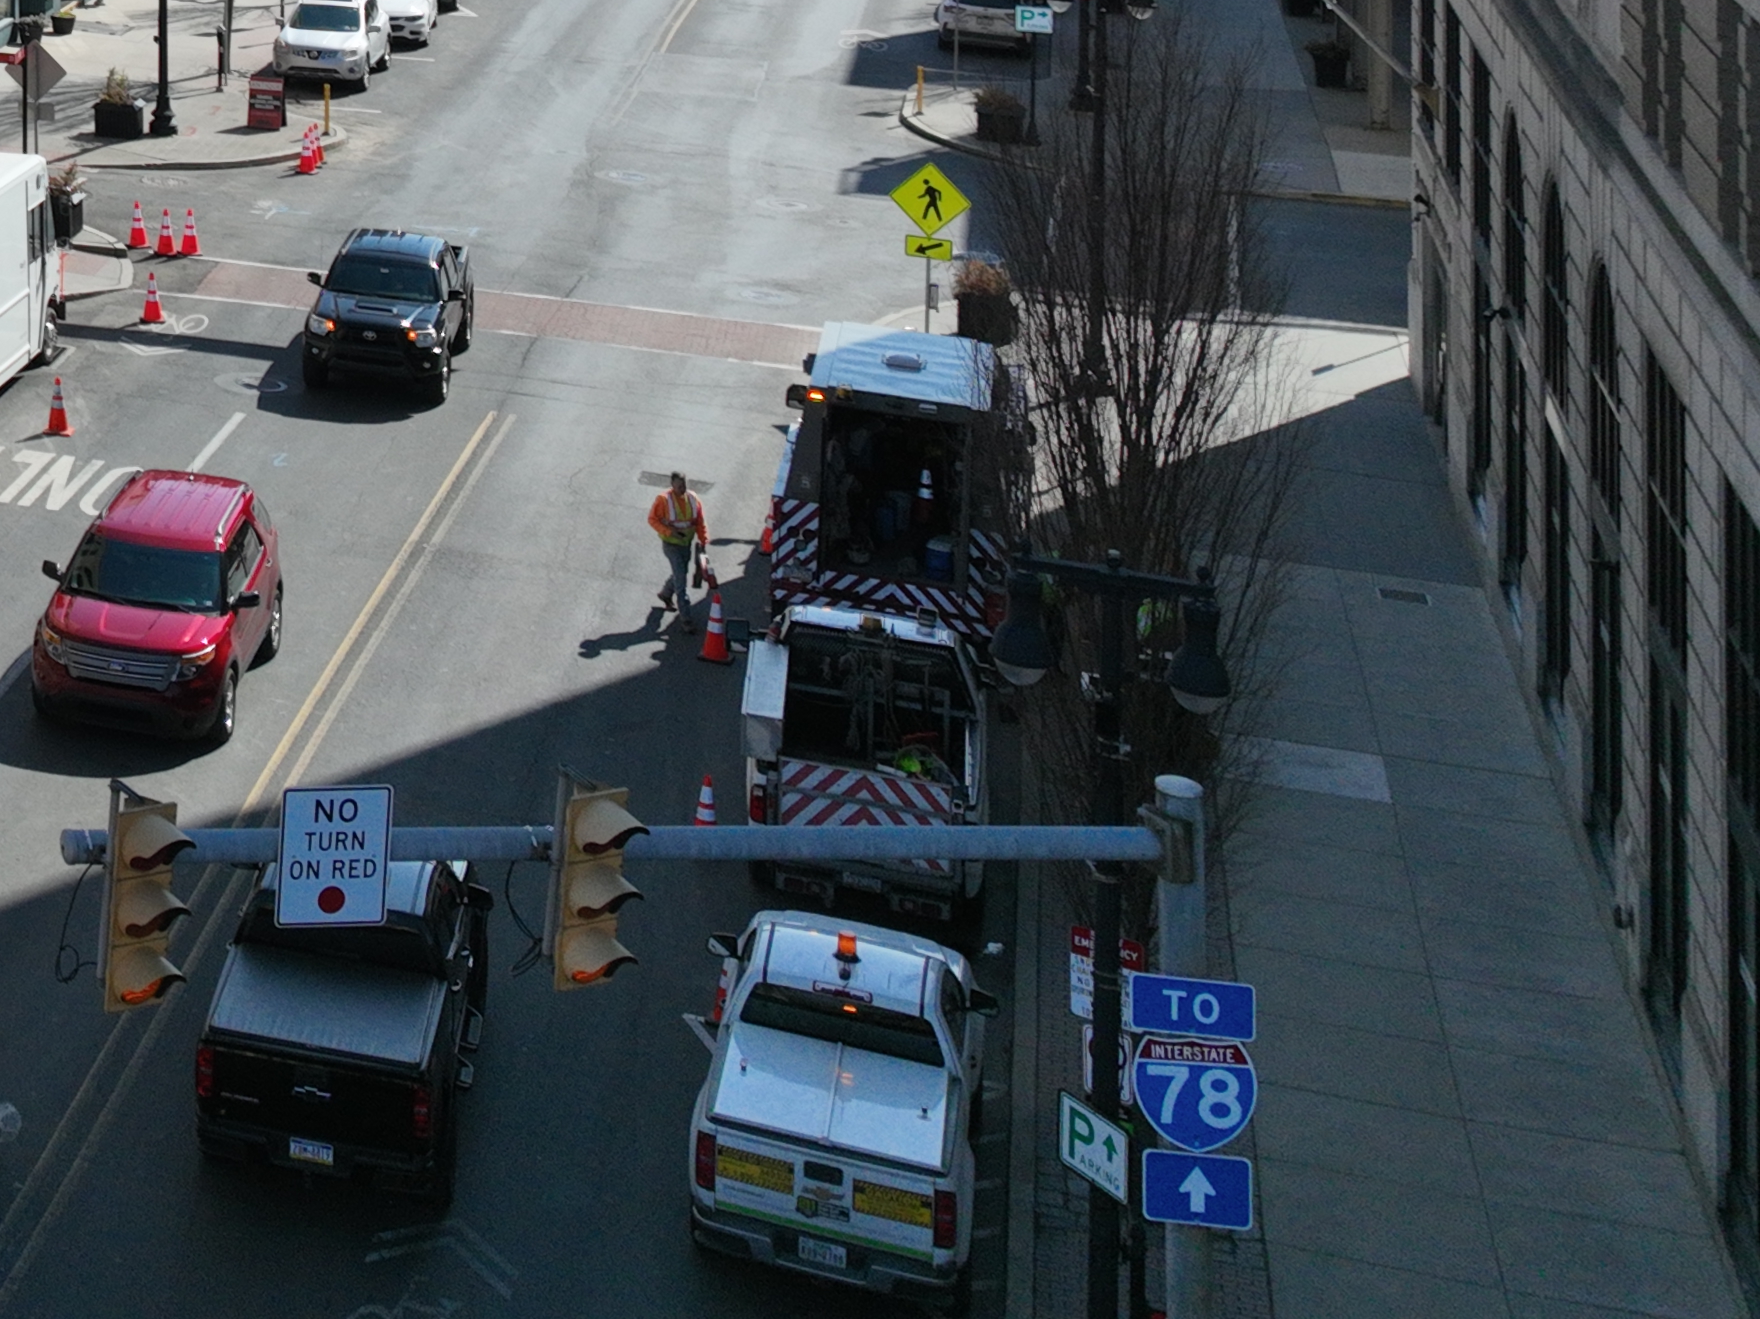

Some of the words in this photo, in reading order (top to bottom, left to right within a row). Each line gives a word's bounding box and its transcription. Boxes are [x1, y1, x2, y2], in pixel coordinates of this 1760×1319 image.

[314, 798, 359, 823] NO
[305, 831, 365, 851] TURN
[290, 860, 320, 880] ON
[332, 859, 377, 879] RED
[1162, 989, 1220, 1024] TO
[1150, 1044, 1235, 1063] INTERSTATE
[1146, 1065, 1242, 1129] 78
